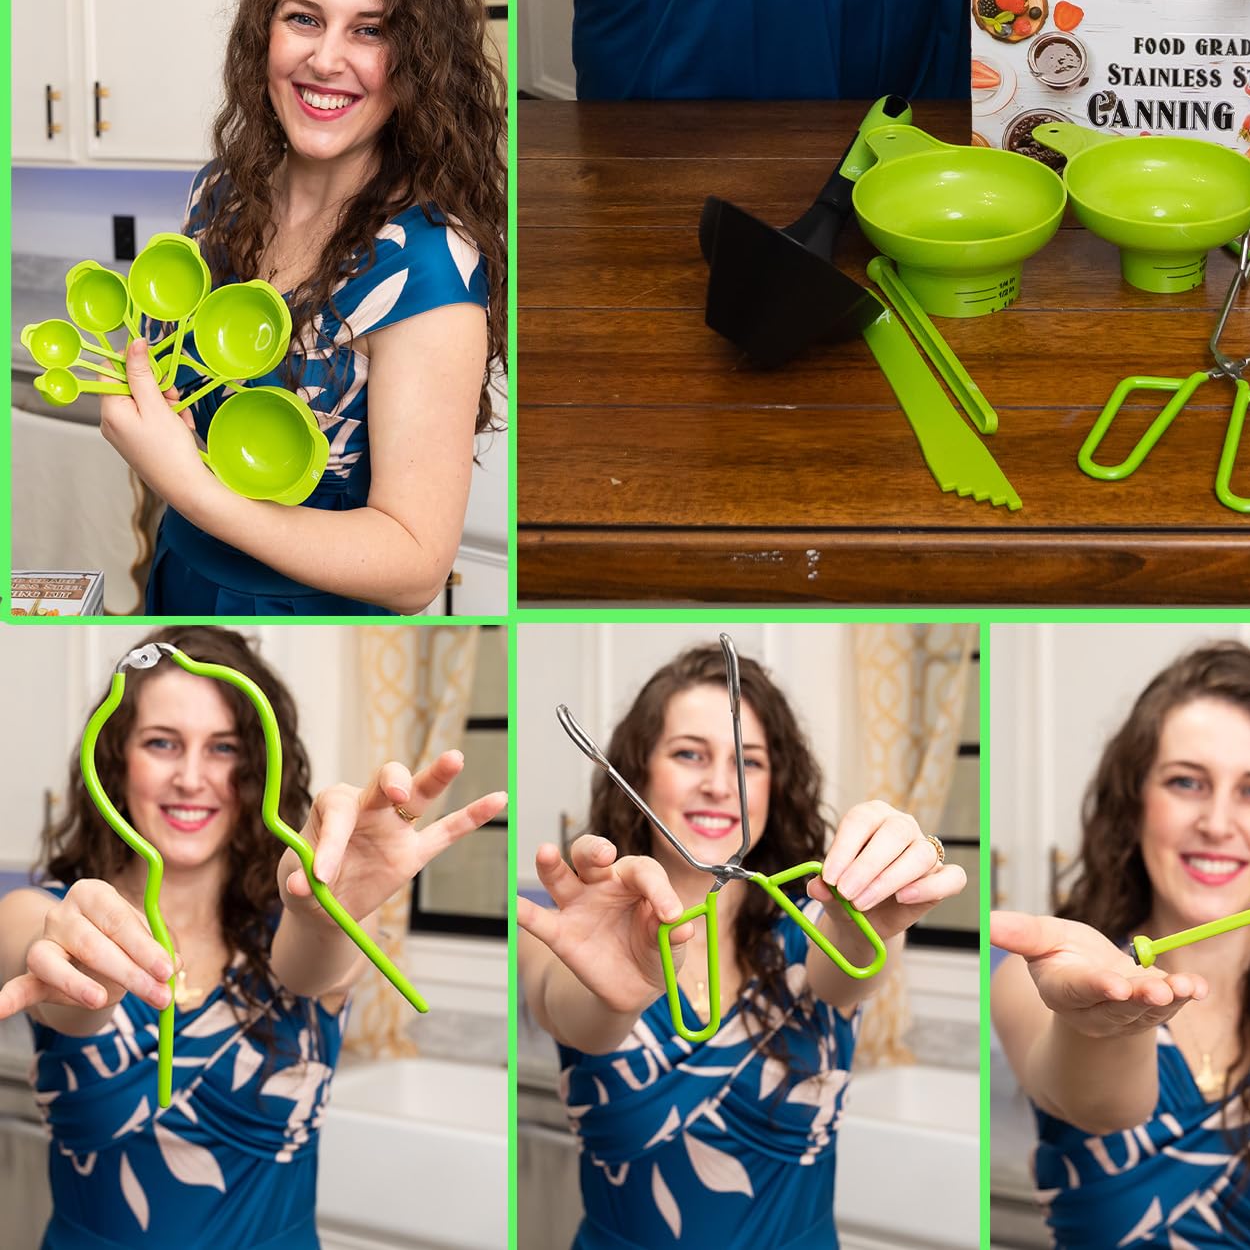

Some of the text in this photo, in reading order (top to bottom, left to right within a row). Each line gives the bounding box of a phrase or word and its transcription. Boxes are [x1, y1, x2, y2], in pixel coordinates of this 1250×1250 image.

[1134, 37, 1186, 55] FOOD
[1108, 62, 1223, 89] STAINLESS
[1087, 90, 1236, 131] CANNING
